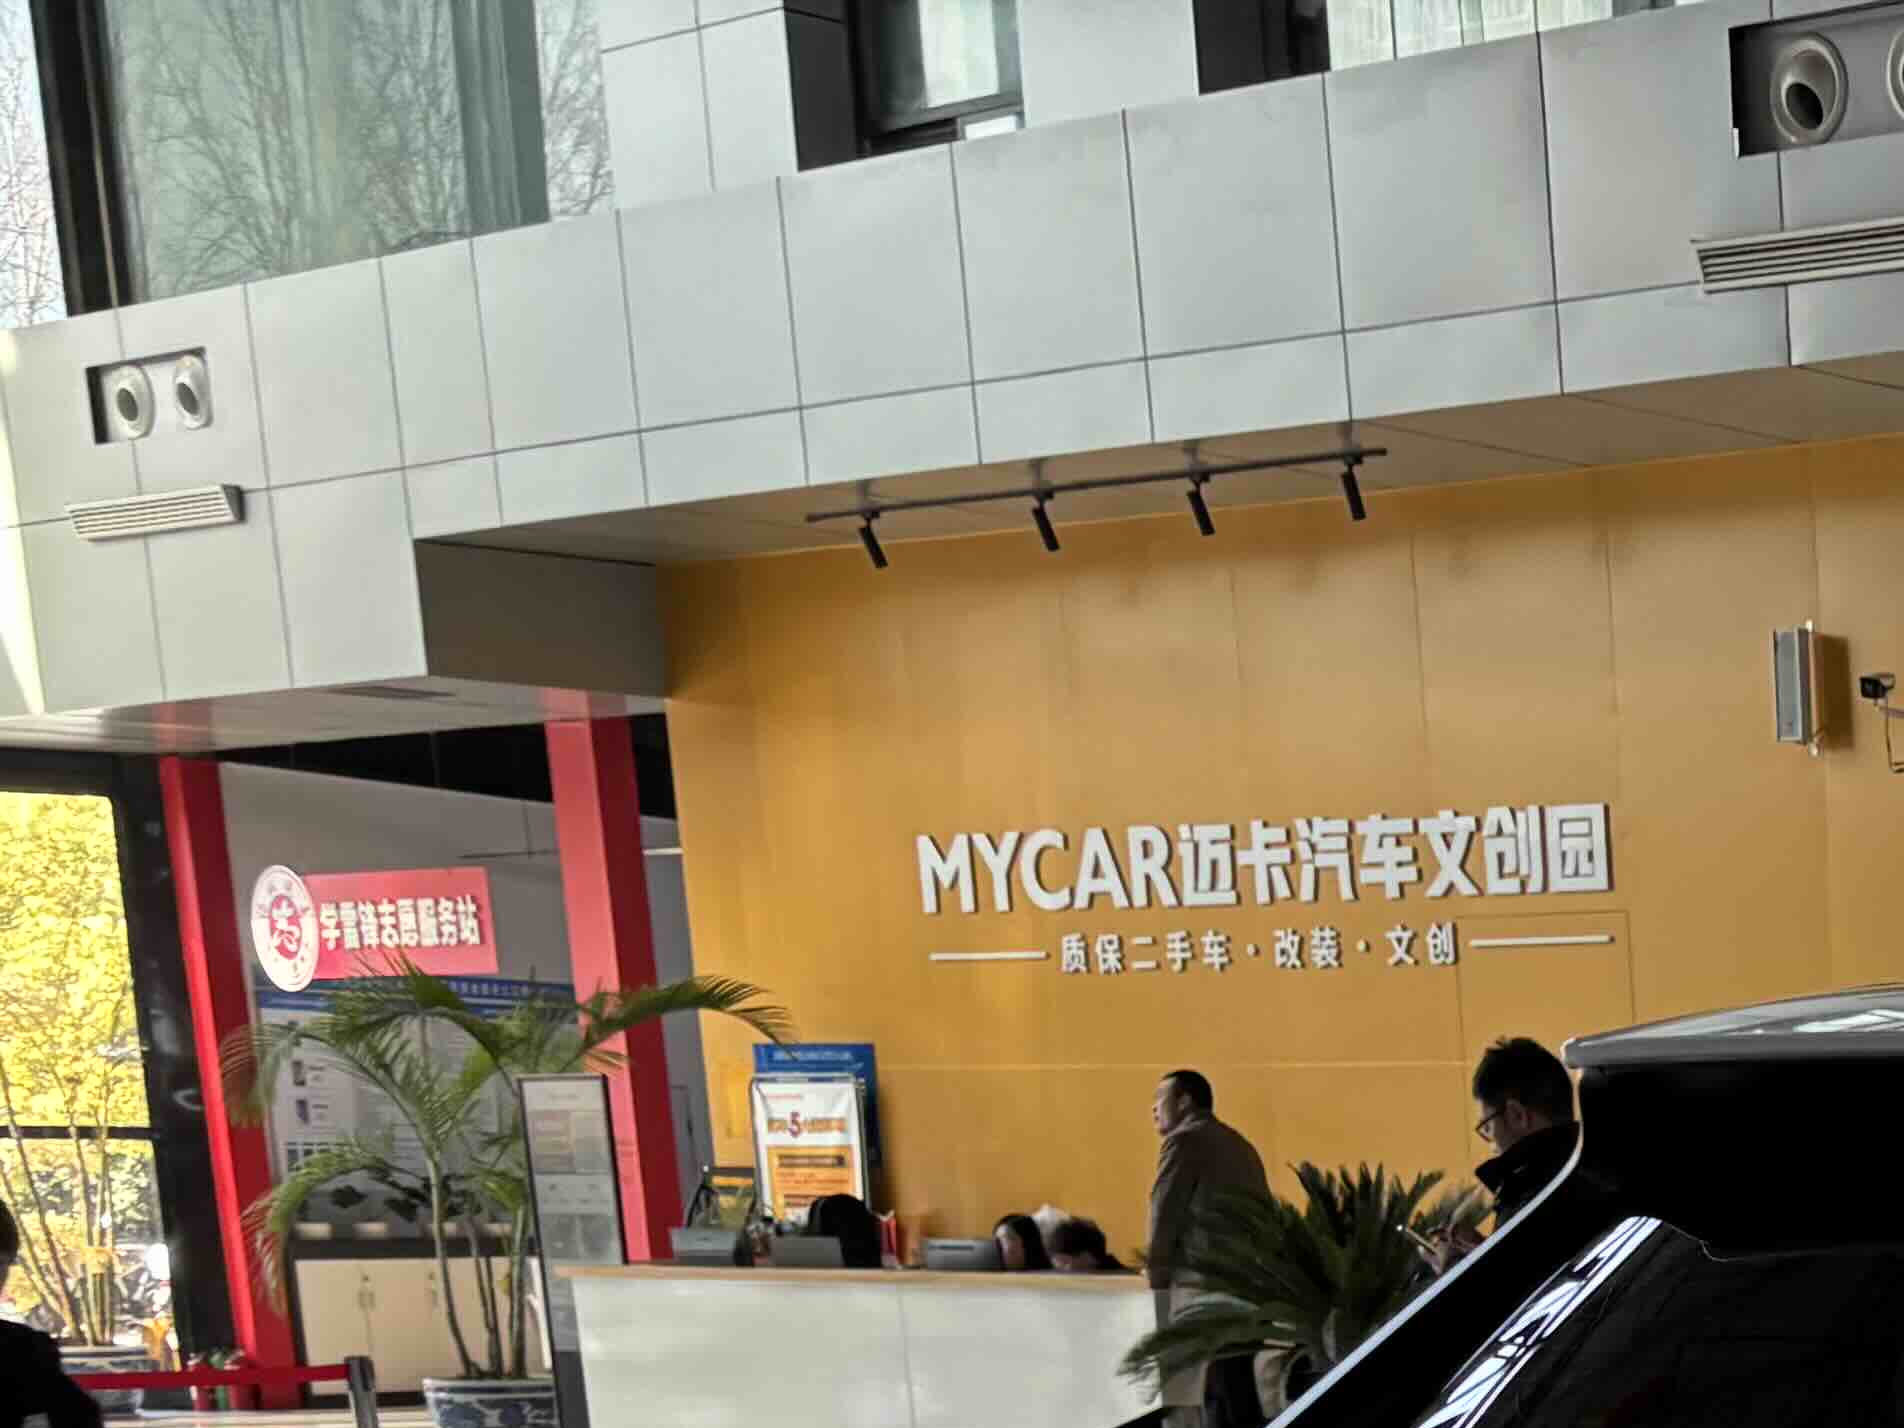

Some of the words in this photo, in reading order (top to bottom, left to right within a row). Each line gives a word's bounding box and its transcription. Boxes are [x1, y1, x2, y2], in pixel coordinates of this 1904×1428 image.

[916, 803, 1613, 914] MYCAR迈卡汽车文创园
